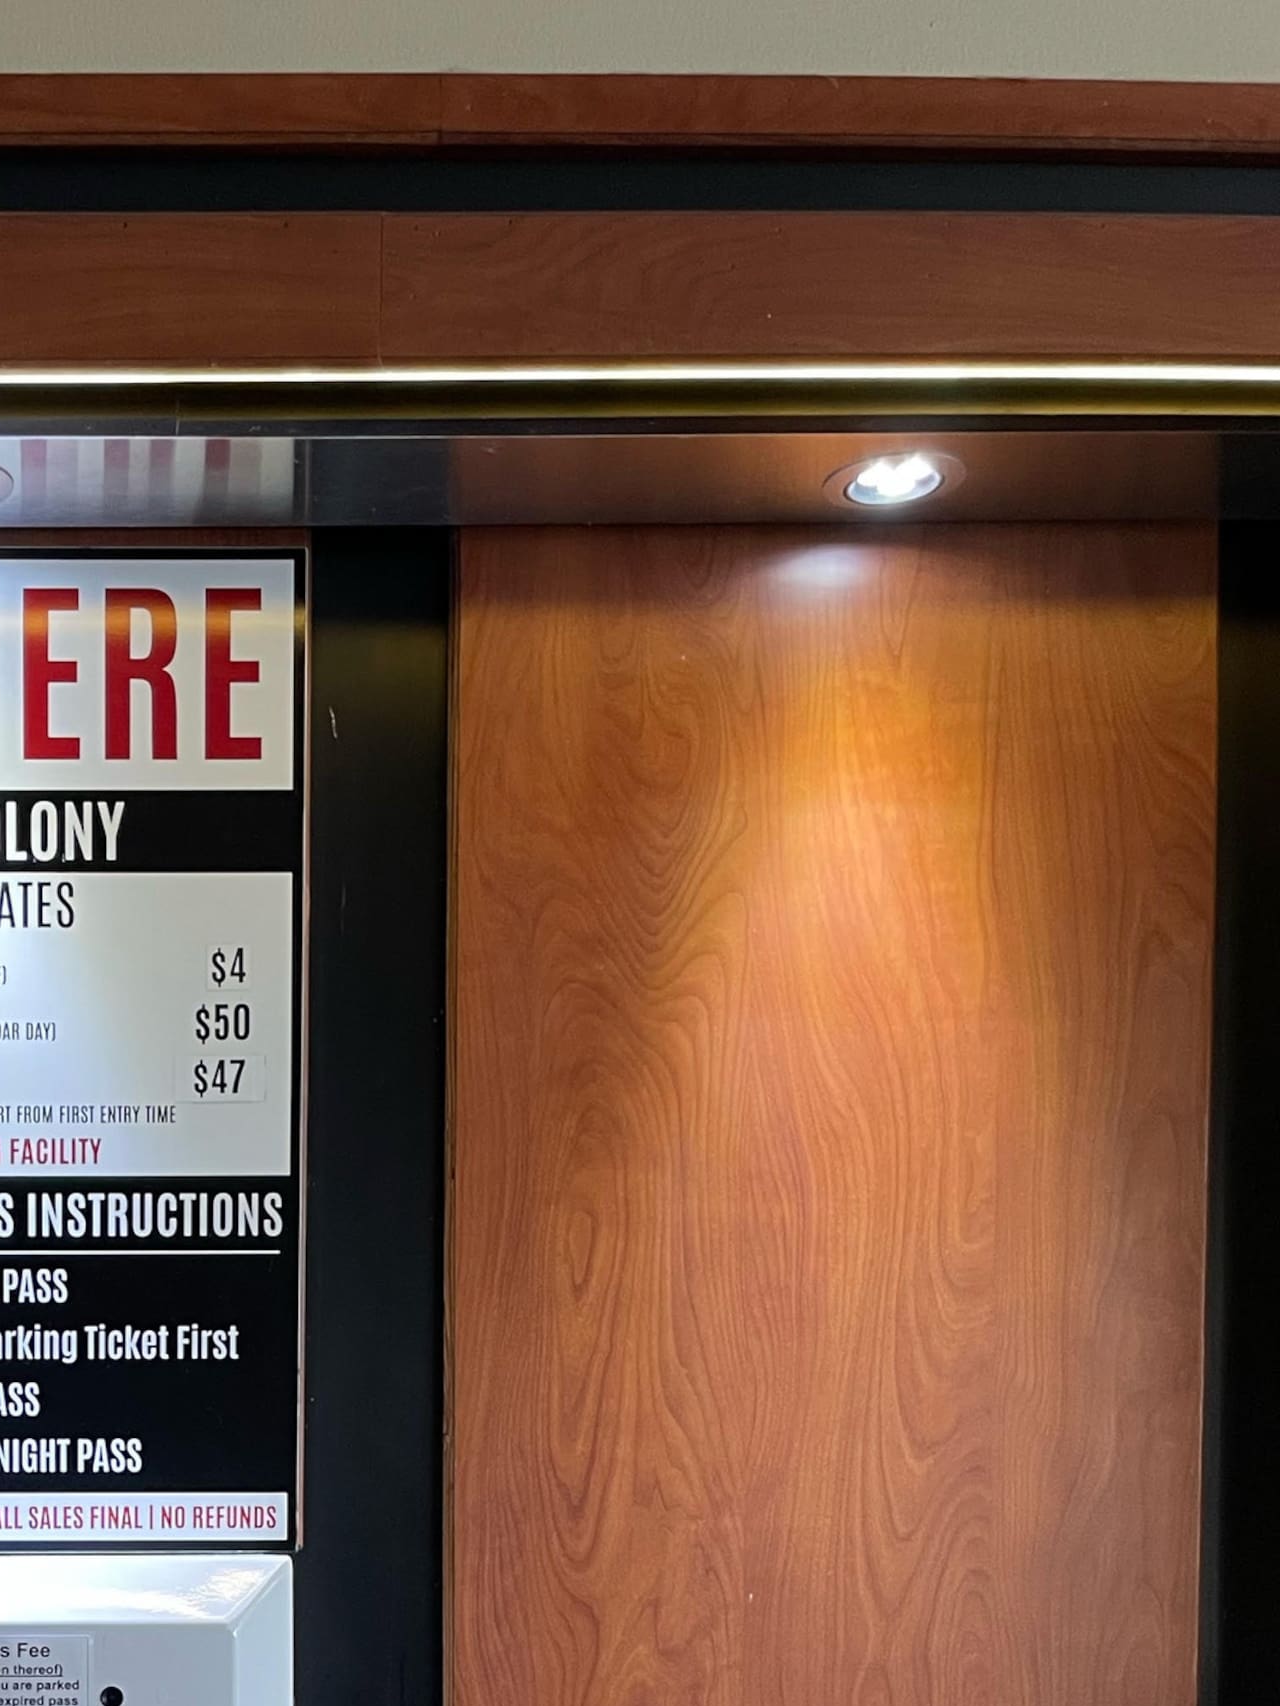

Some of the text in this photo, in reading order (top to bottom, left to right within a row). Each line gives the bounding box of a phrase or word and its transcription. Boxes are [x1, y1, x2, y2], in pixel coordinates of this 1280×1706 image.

[211, 947, 247, 988] $4
[25, 1021, 56, 1042] DAY)
[195, 1003, 250, 1045] $50
[193, 1059, 246, 1099] $47
[16, 1105, 53, 1124] FROM
[59, 1105, 95, 1124] FIRST
[100, 1105, 141, 1124] ENTRY
[145, 1105, 176, 1124] TIME
[10, 1137, 102, 1165] FACILITY
[27, 1191, 283, 1238] INSTRUCTIONS
[2, 1268, 69, 1304] PASS
[83, 1323, 170, 1361] Ticket
[176, 1323, 240, 1360] First
[77, 1437, 143, 1474] PASS
[28, 1505, 84, 1530] SALES
[90, 1505, 143, 1529] FINAL
[161, 1505, 185, 1529] NO
[192, 1505, 277, 1529] REFUNDS
[17, 1642, 51, 1659] Fee
[13, 1664, 63, 1678] thereof)
